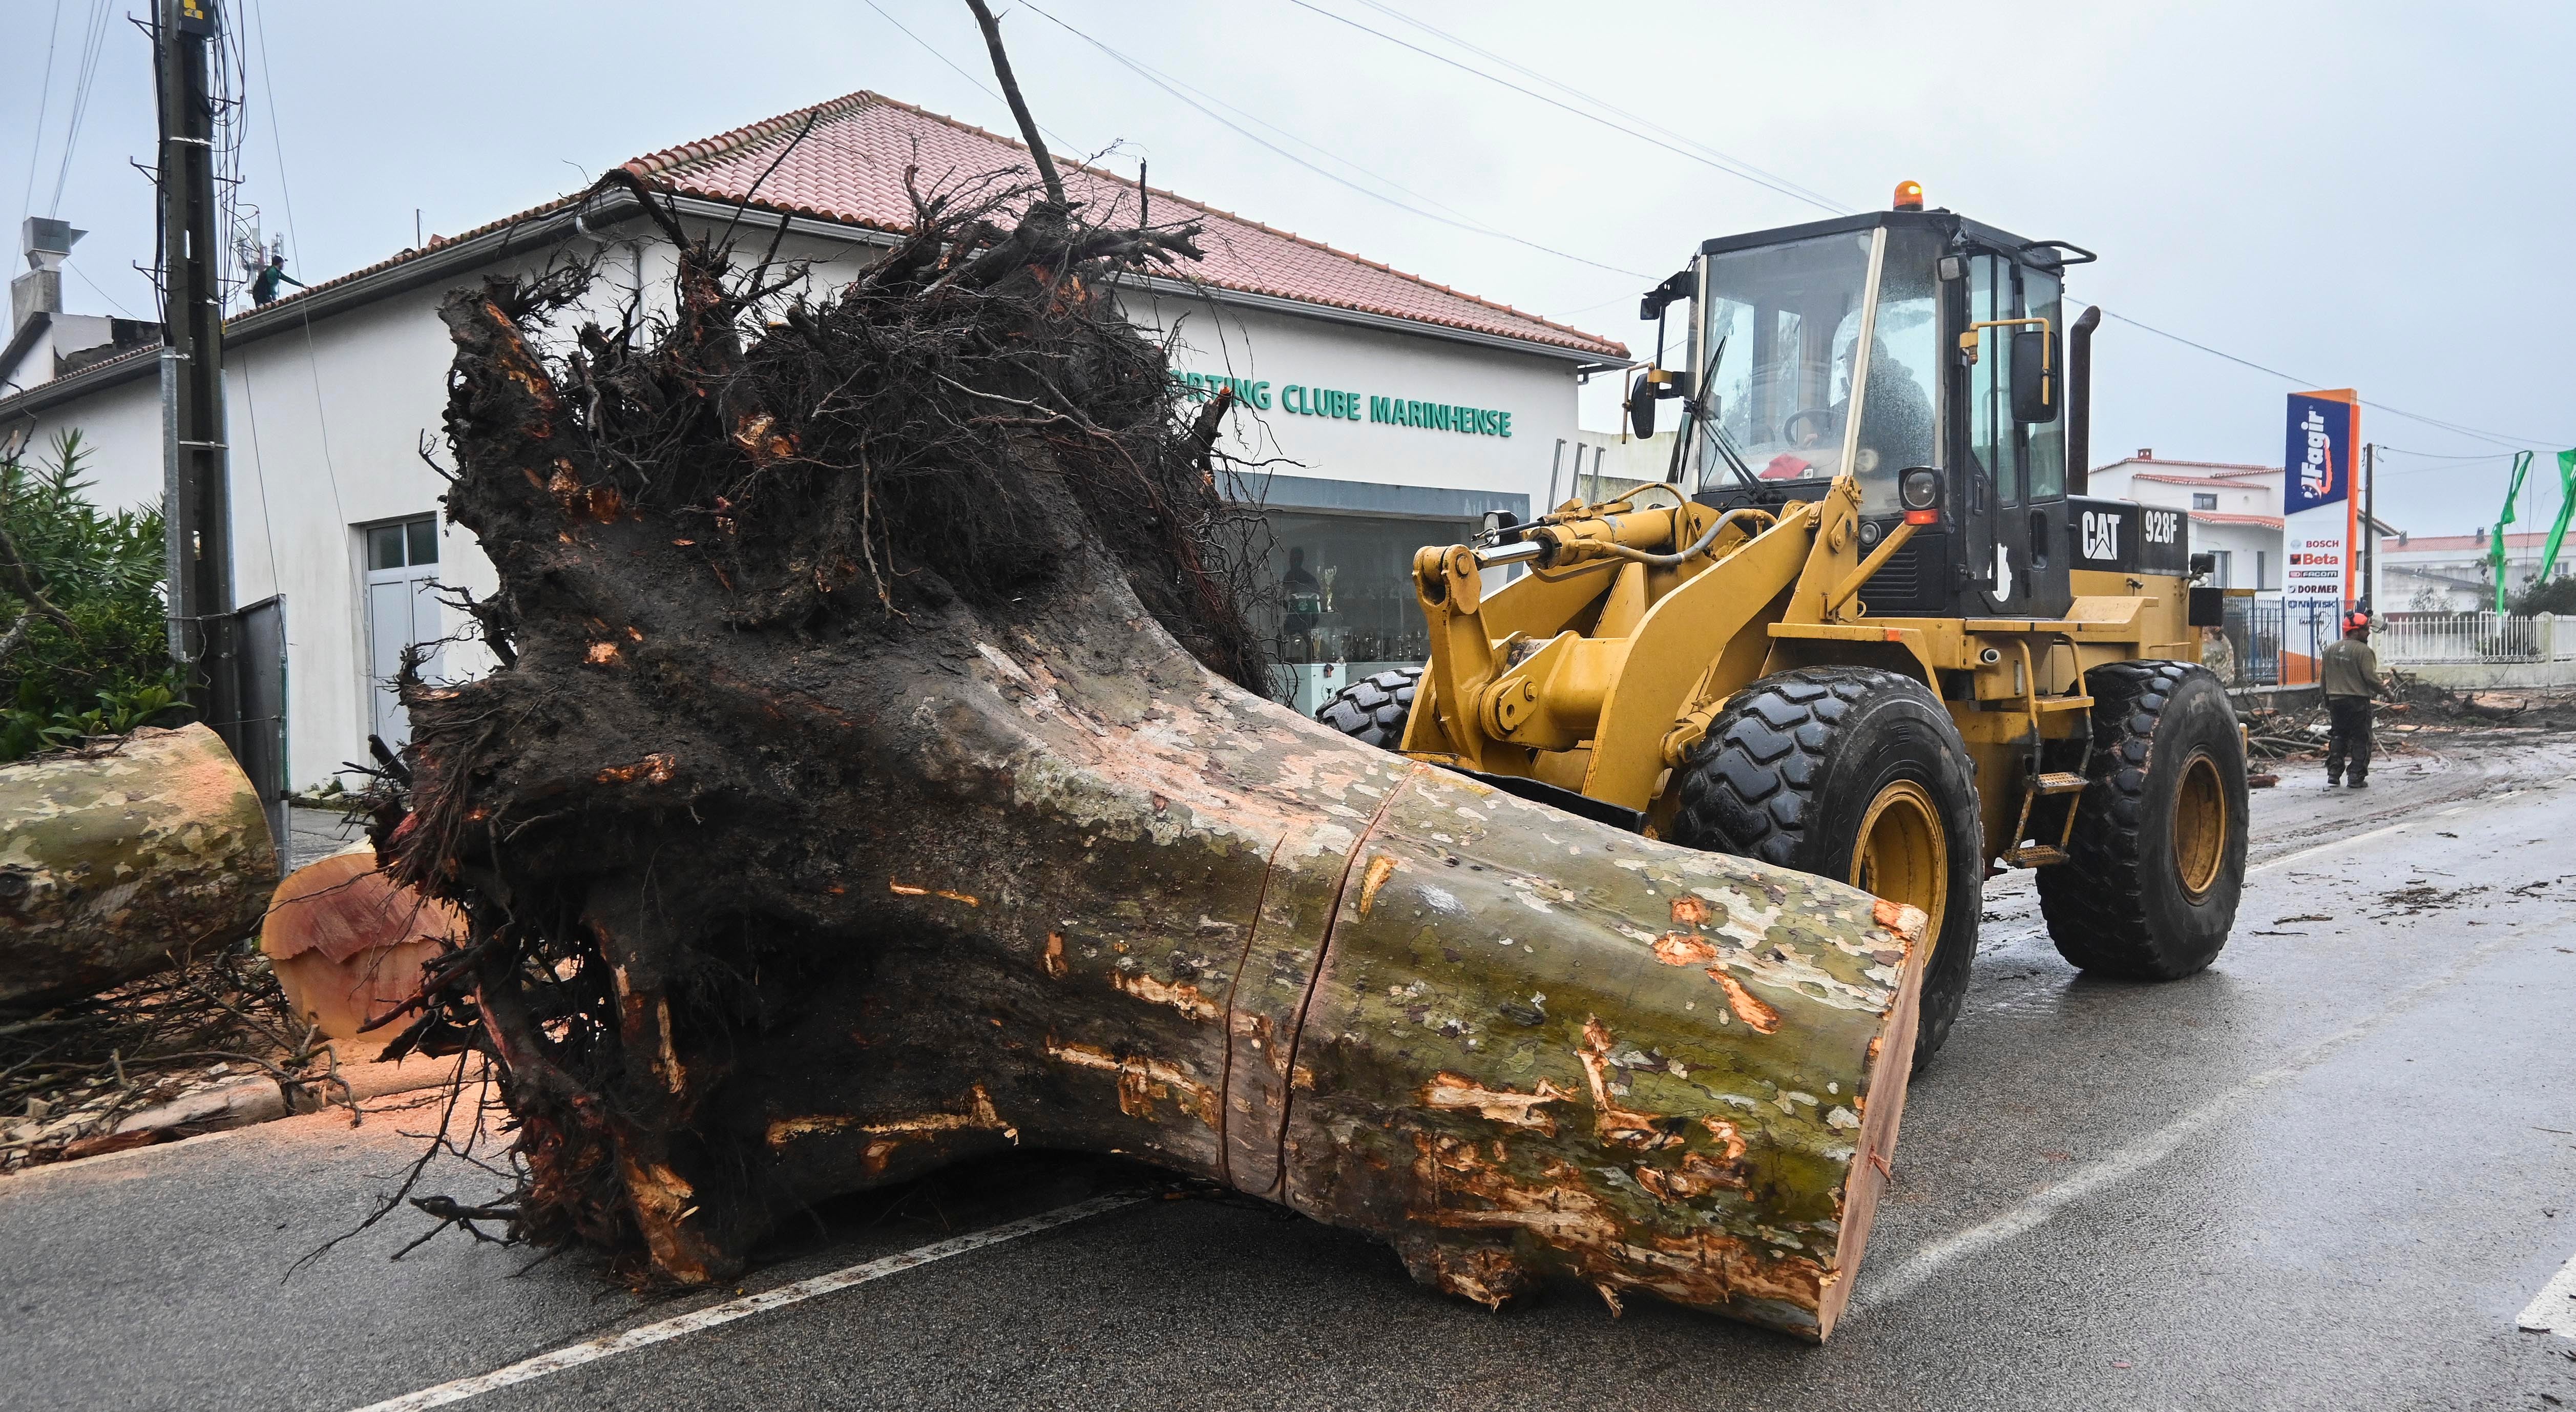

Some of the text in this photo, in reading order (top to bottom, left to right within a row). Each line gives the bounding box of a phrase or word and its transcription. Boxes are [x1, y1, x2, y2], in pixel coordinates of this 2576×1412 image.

[1282, 385, 1361, 420] CLUBE
[1371, 396, 1512, 437] MARINHENSE
[2082, 511, 2120, 560] CAT
[2145, 510, 2177, 543] 928F
[2303, 553, 2338, 565] Beta
[2298, 585, 2337, 593] DORMER
